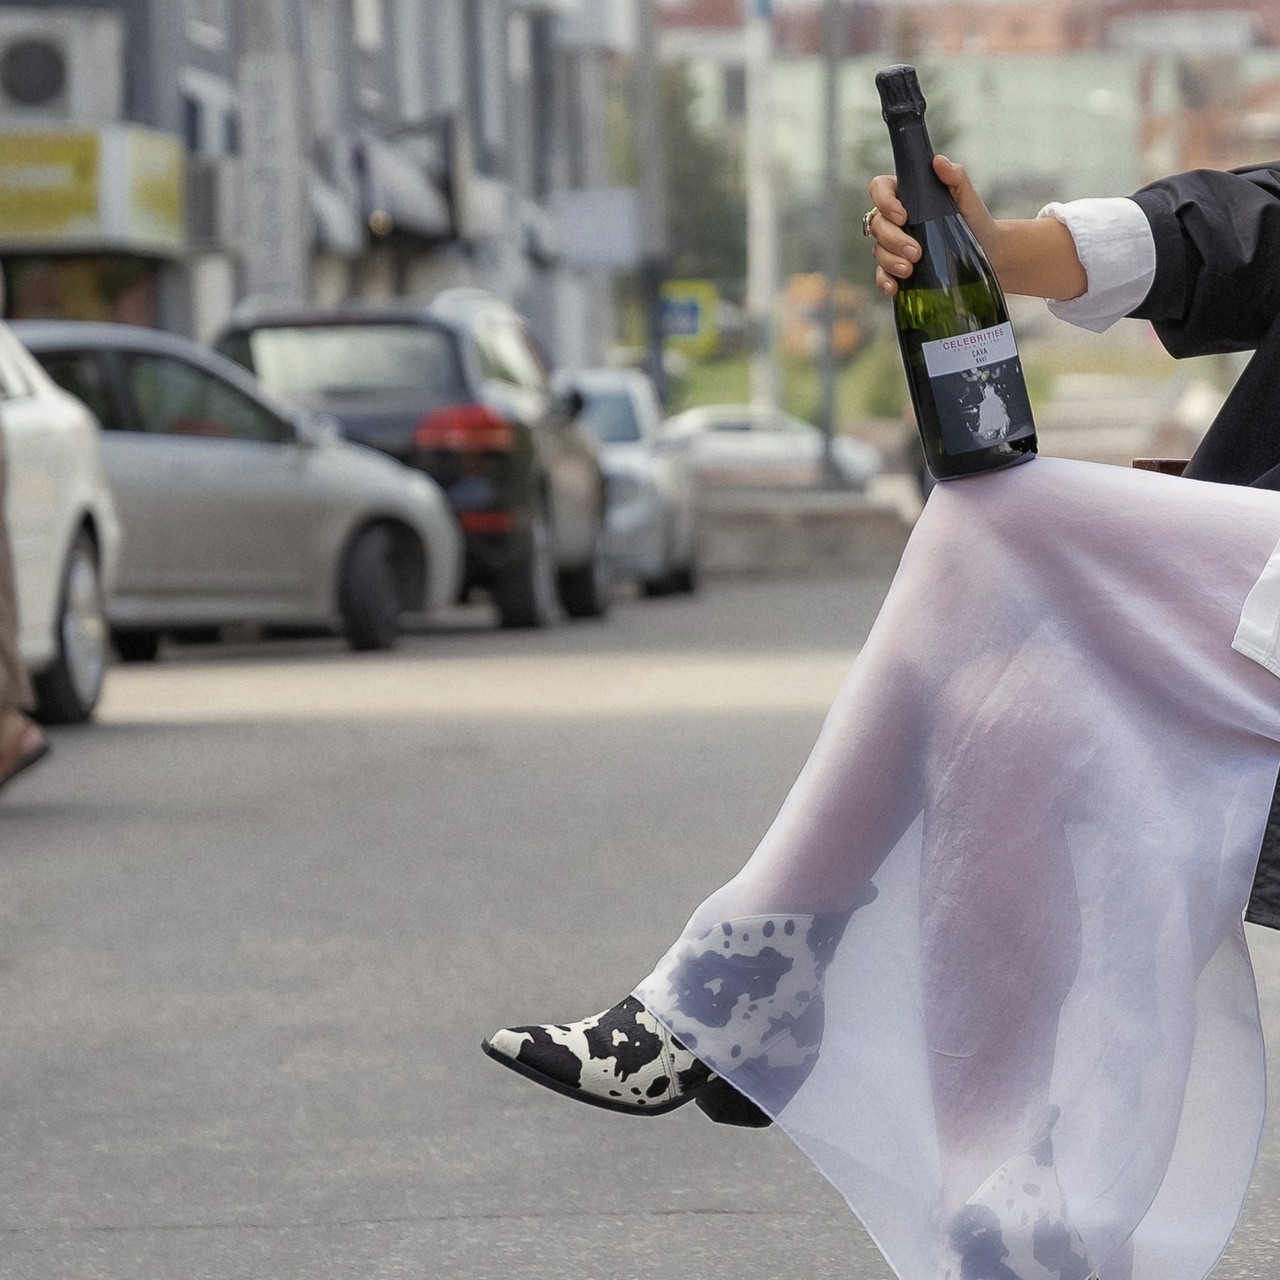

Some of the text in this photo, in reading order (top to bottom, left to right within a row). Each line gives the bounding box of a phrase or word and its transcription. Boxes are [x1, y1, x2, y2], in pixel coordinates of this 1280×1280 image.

[942, 328, 1005, 350] CELEBRITIES
[971, 347, 988, 358] CAVA
[975, 356, 988, 364] BRUT
